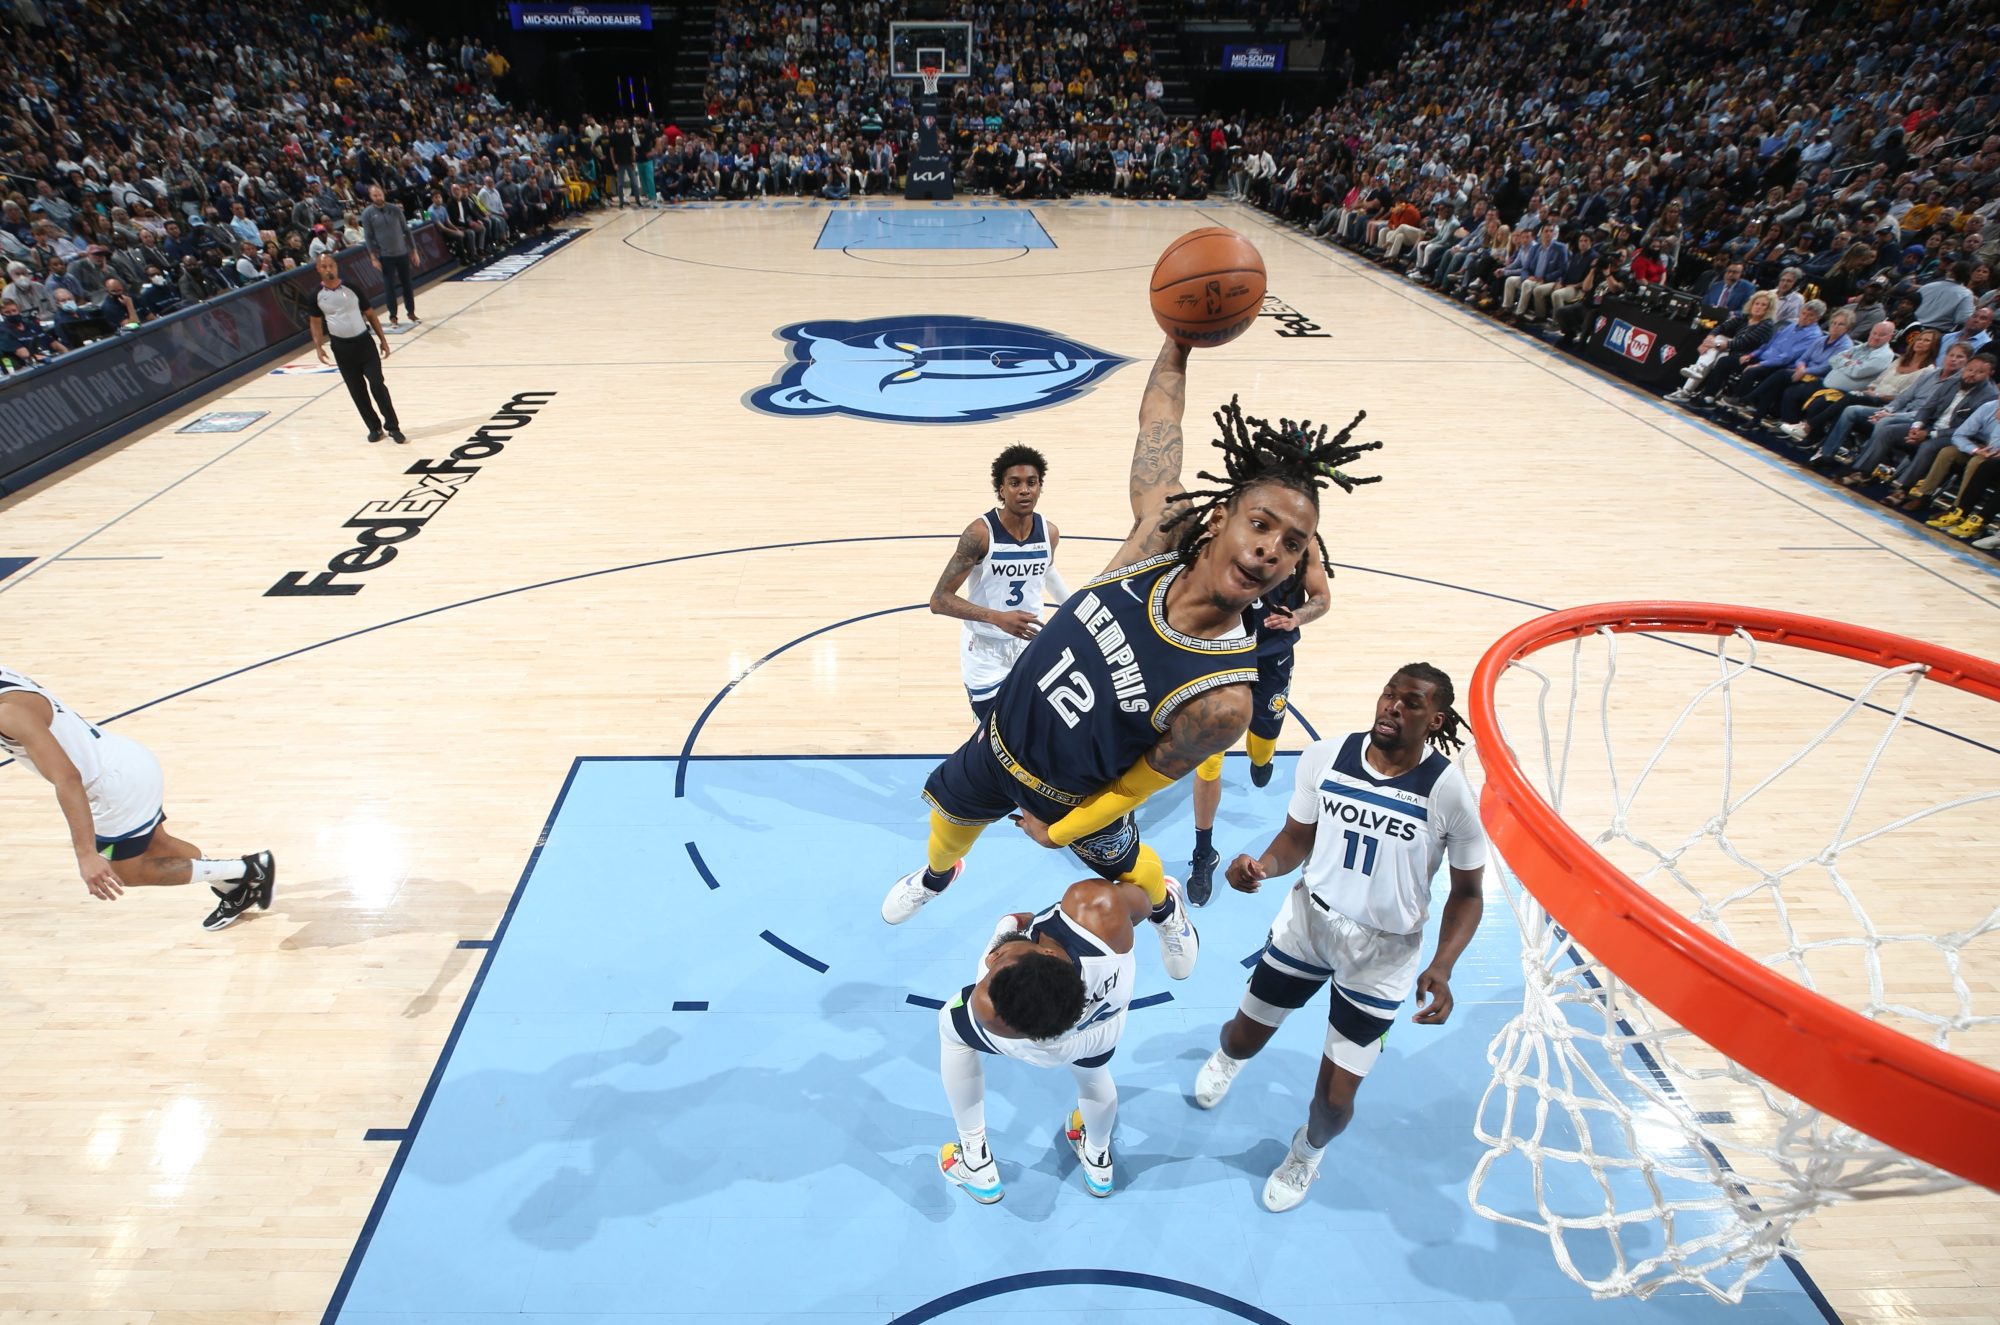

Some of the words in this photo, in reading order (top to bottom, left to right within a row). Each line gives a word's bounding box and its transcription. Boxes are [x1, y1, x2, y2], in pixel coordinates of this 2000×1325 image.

[523, 15, 575, 25] MID-SOUTH
[577, 15, 601, 25] FORD
[603, 15, 641, 25] DEALERS
[913, 171, 945, 181] KIA
[60, 375, 103, 416] 10
[88, 370, 128, 407] PM
[112, 363, 144, 397] ET
[262, 391, 557, 596] FedExForum
[991, 563, 1046, 577] WOLVES
[1005, 580, 1027, 607] 3
[1073, 591, 1150, 713] MEMPHIS
[1037, 646, 1096, 729] 12
[1322, 796, 1417, 841] WOLVES
[1343, 829, 1379, 877] 11
